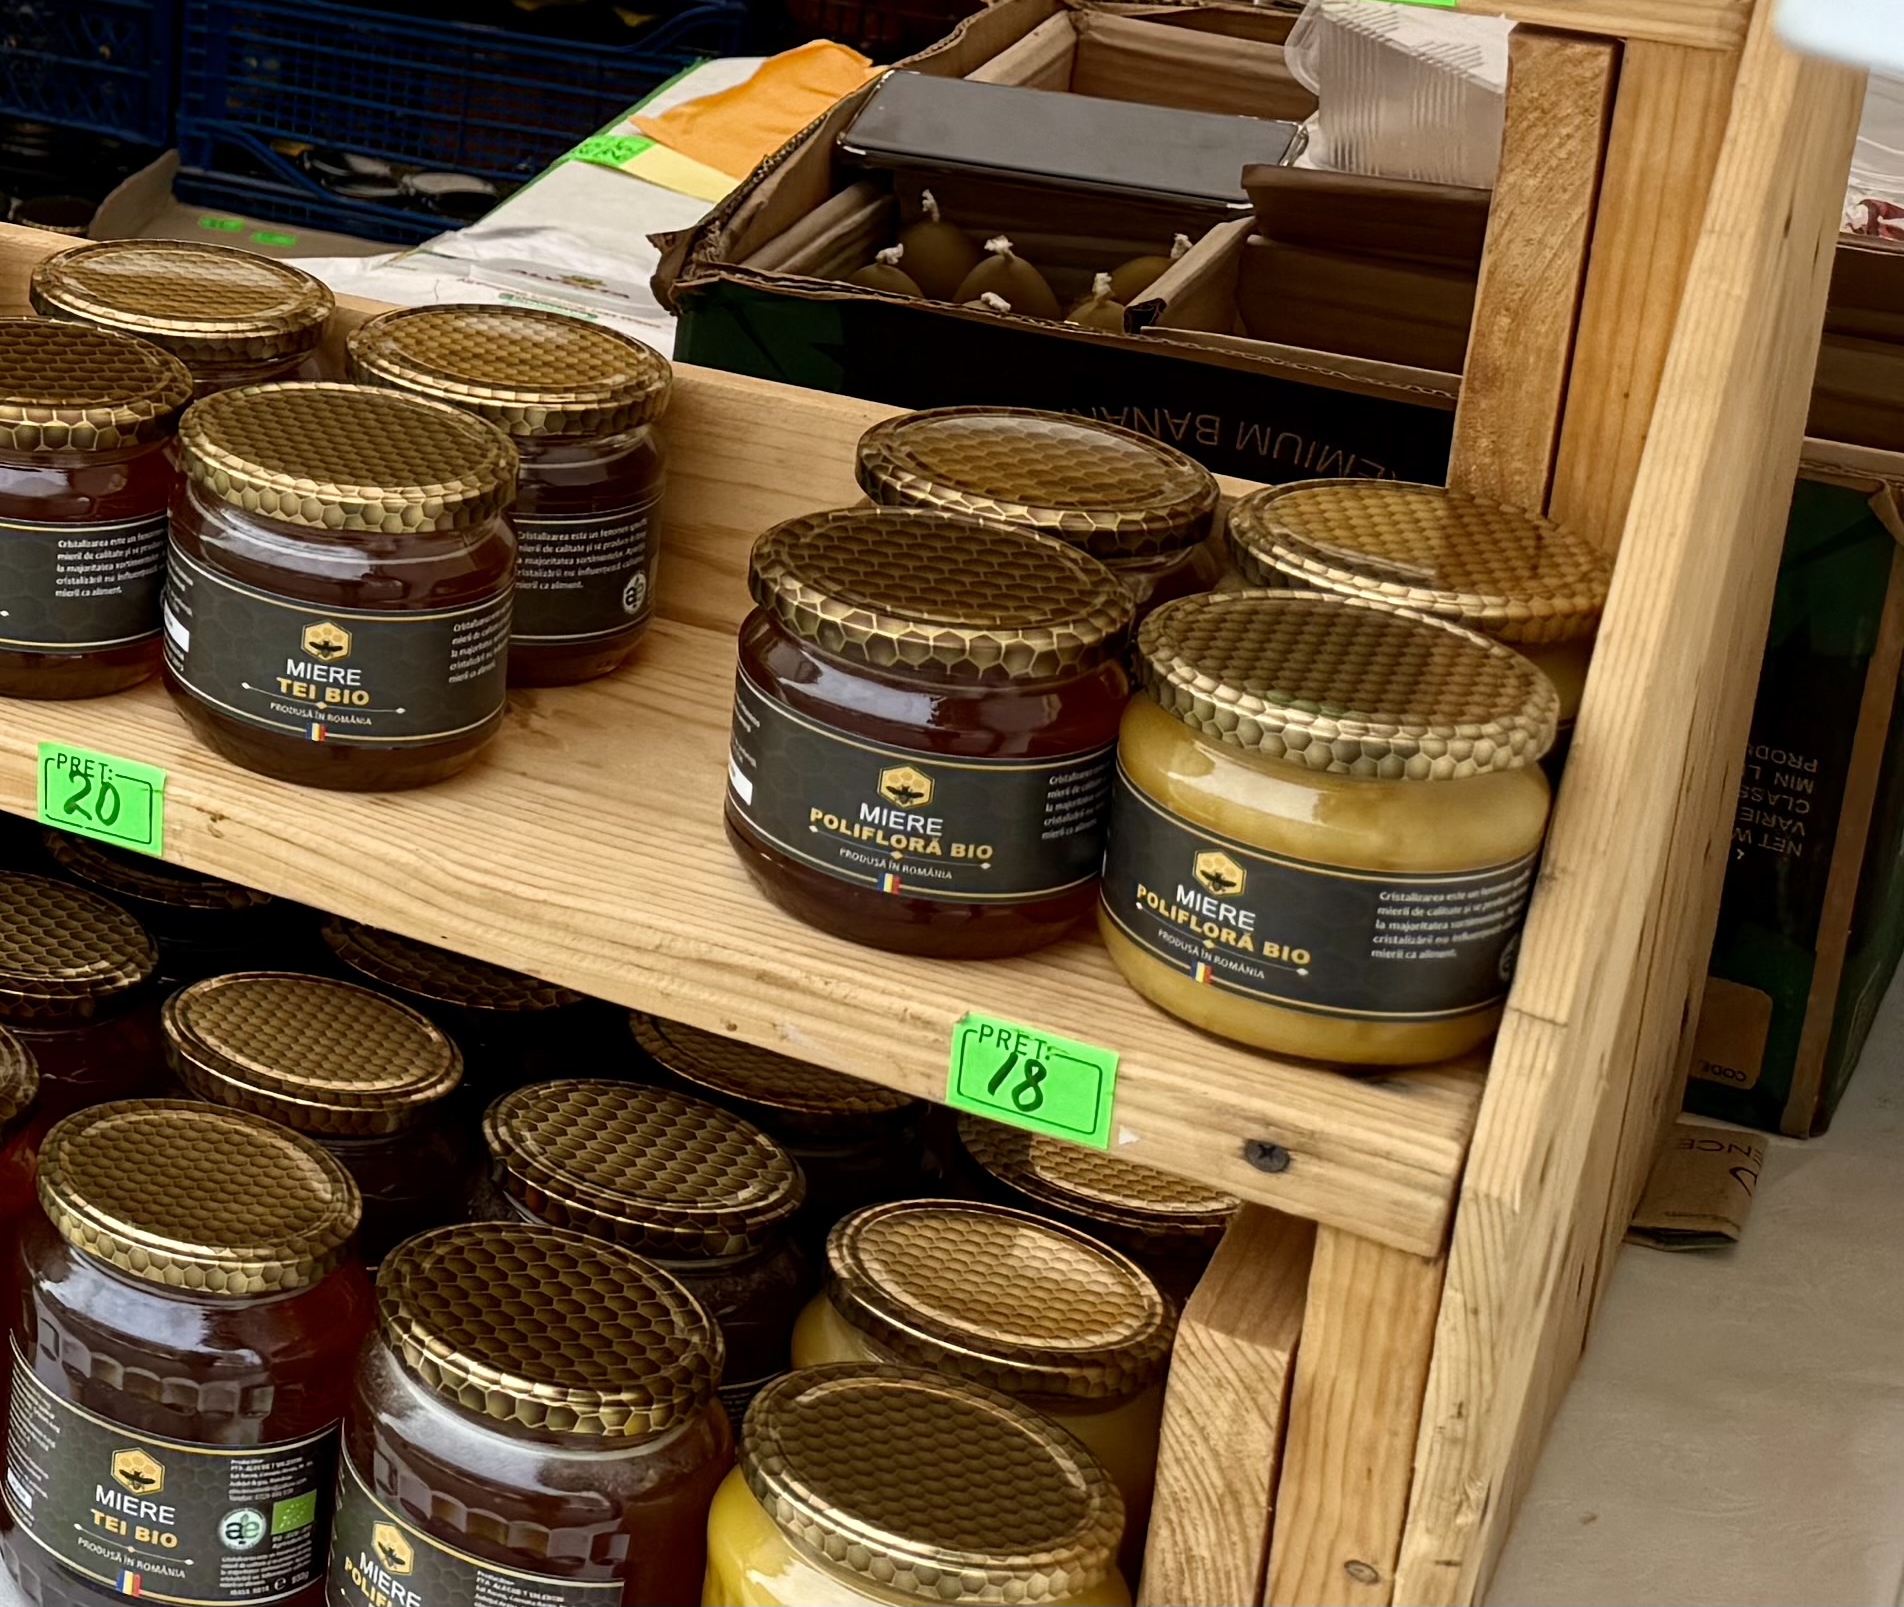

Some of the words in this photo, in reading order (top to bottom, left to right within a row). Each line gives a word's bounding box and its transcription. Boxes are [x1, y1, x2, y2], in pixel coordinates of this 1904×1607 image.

[276, 677, 318, 700] TEI
[325, 684, 370, 707] BIO
[286, 658, 361, 686] MIERE
[64, 779, 122, 829] 20
[859, 802, 944, 836] MIERE
[809, 807, 942, 854] POLIFLORĂ
[950, 840, 994, 861] BIO
[1135, 883, 1254, 953] POLIFLORĂ
[1262, 940, 1311, 967] BIO
[1176, 883, 1256, 931] MIERE
[987, 1051, 1045, 1113] 18
[96, 1485, 175, 1524] MIERE
[90, 1508, 128, 1535] TEI
[135, 1525, 177, 1549] BIO
